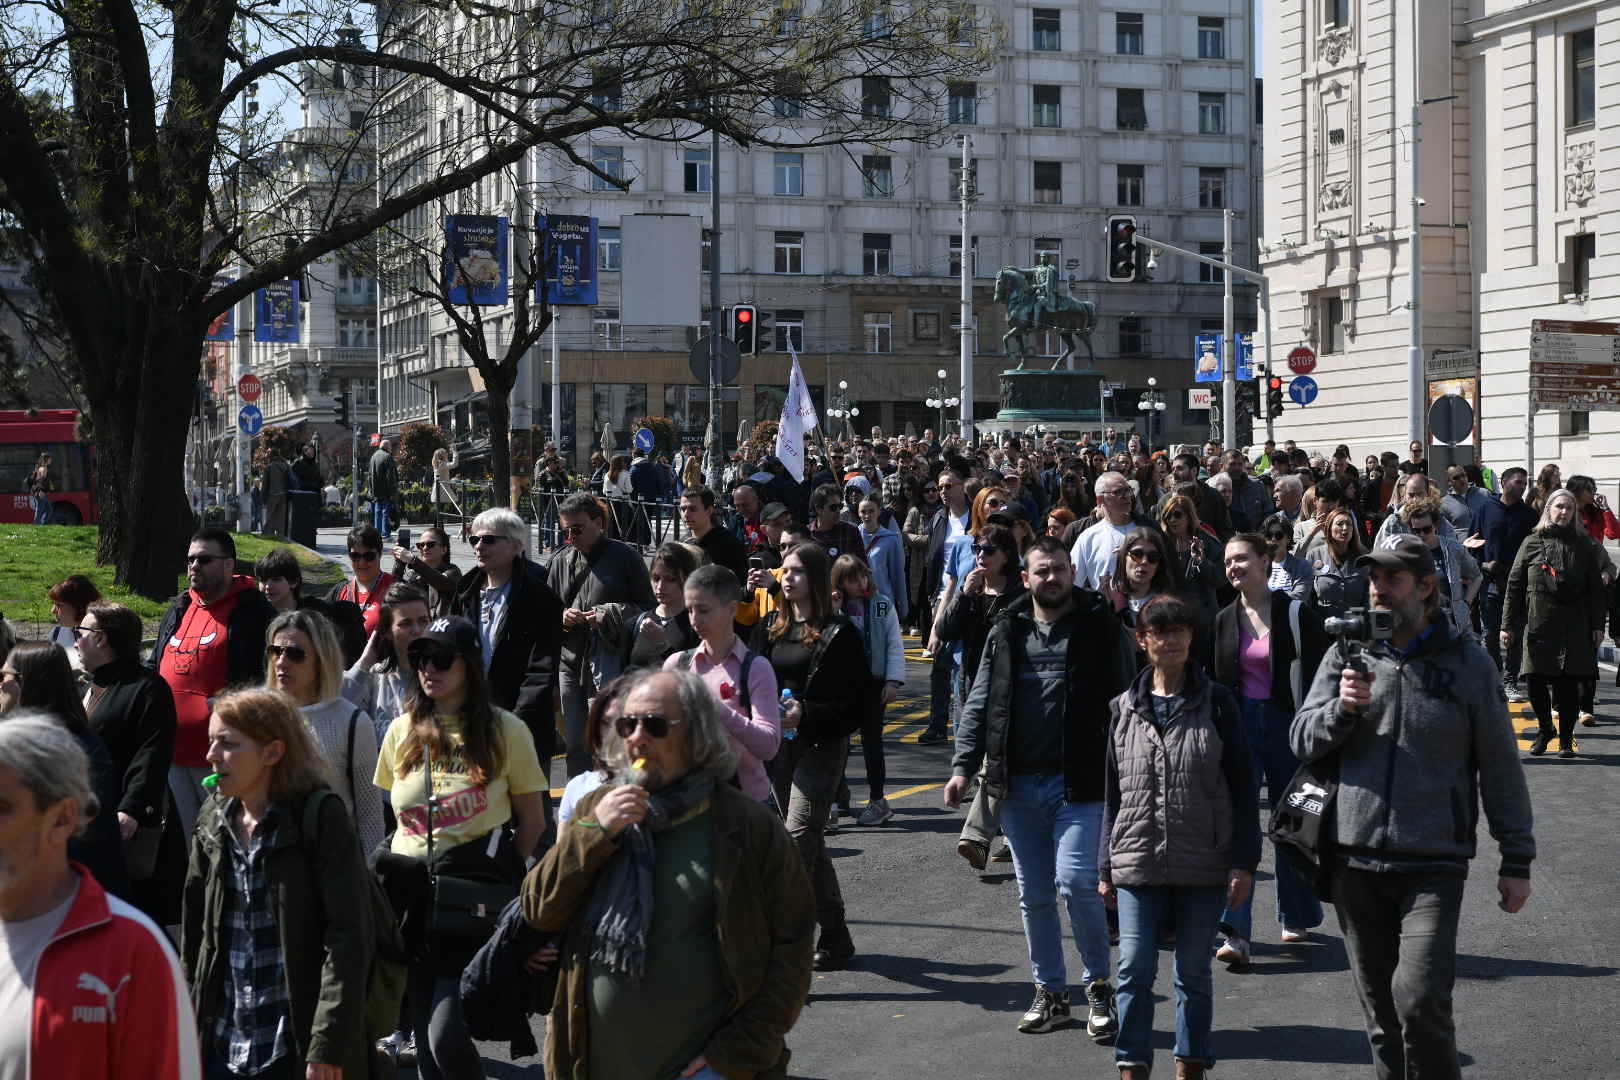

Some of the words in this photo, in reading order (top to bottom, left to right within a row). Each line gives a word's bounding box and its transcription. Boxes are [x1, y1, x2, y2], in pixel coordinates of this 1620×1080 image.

[1290, 356, 1314, 368] STOP
[240, 383, 260, 393] STOP
[1193, 394, 1210, 404] WC
[1380, 533, 1403, 551] NY
[430, 618, 450, 633] NY
